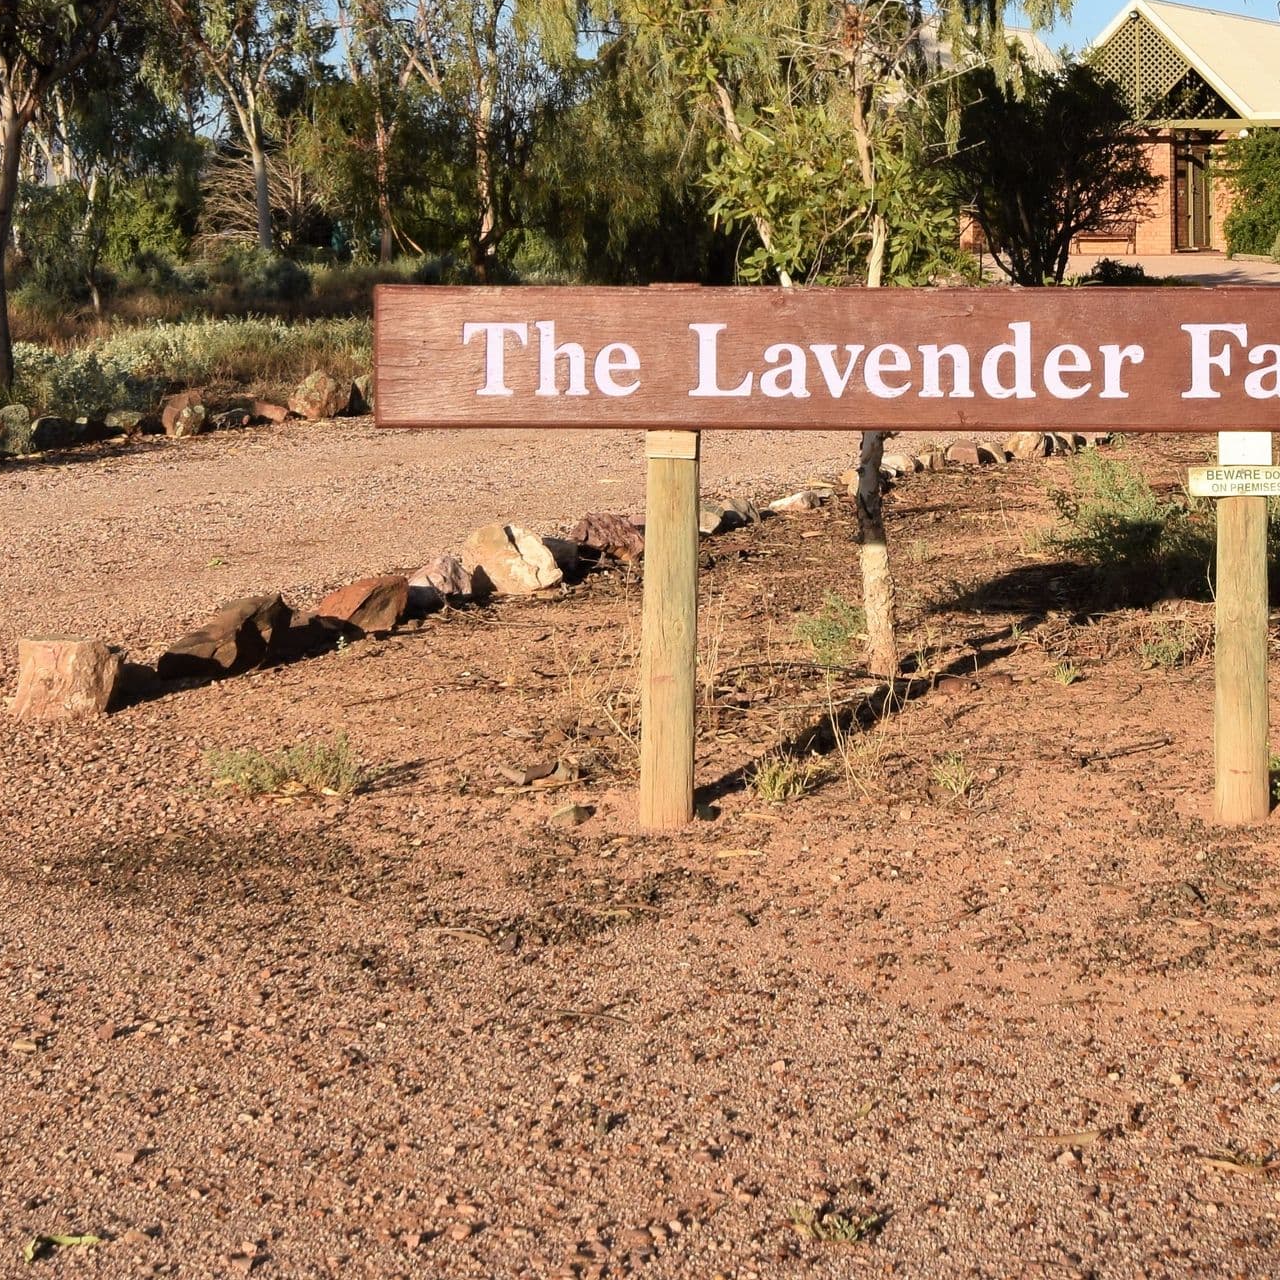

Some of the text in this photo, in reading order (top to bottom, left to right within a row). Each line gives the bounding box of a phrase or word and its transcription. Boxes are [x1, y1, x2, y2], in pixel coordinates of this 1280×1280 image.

[462, 319, 642, 399] The
[687, 320, 1145, 400] Lavender
[1206, 469, 1261, 480] BEWARE
[1211, 483, 1227, 493] ON
